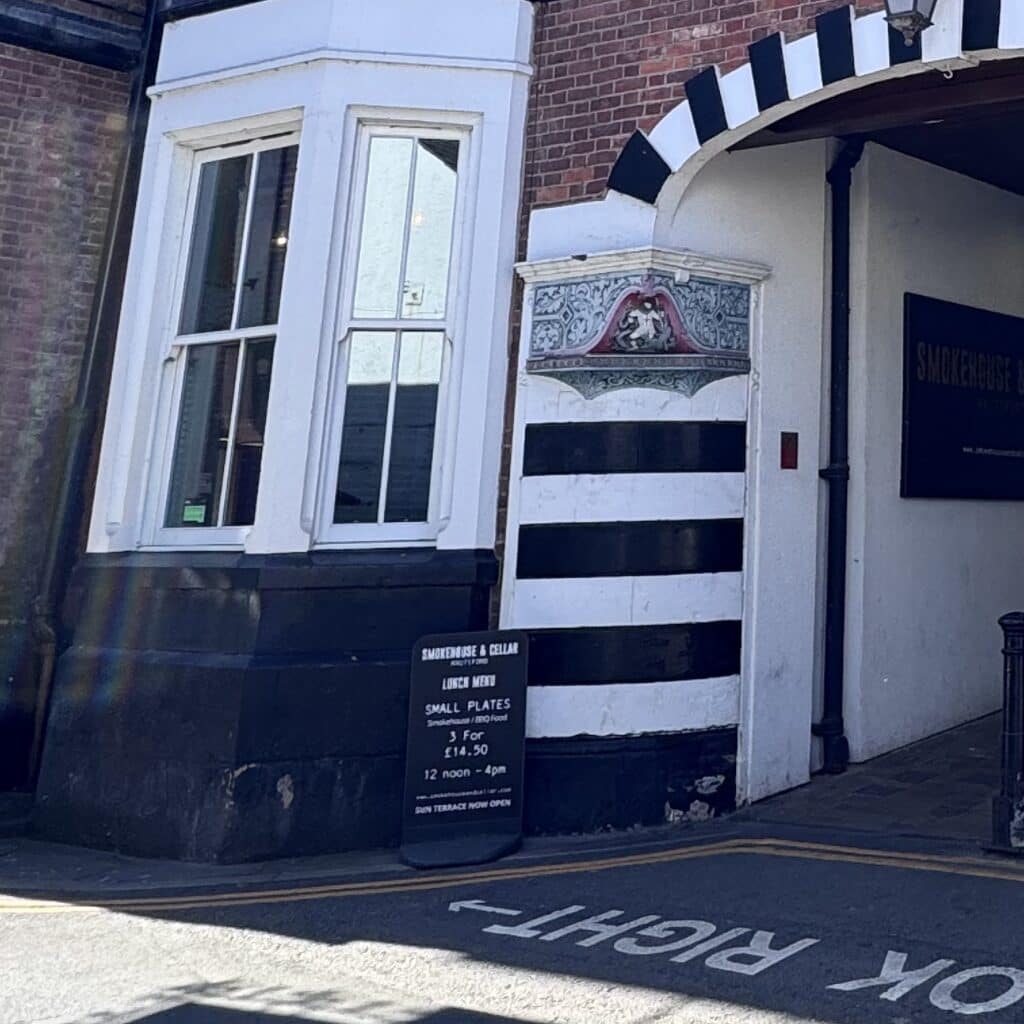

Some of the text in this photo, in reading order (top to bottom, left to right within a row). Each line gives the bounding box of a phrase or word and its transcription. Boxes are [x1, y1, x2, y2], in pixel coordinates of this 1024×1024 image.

[916, 341, 1012, 393] SMOKEHOUSE
[421, 642, 519, 661] SMOKEHOUSE & CELLAR
[442, 674, 496, 690] LUNCH MENU
[425, 698, 511, 716] SMALL PLATES
[448, 730, 485, 743] 3 For
[444, 743, 488, 758] £14.50
[424, 769, 437, 780] 12
[442, 768, 471, 779] noon
[415, 799, 512, 815] SUN TERRACE NOW OPEN
[481, 904, 821, 976] RIGHT
